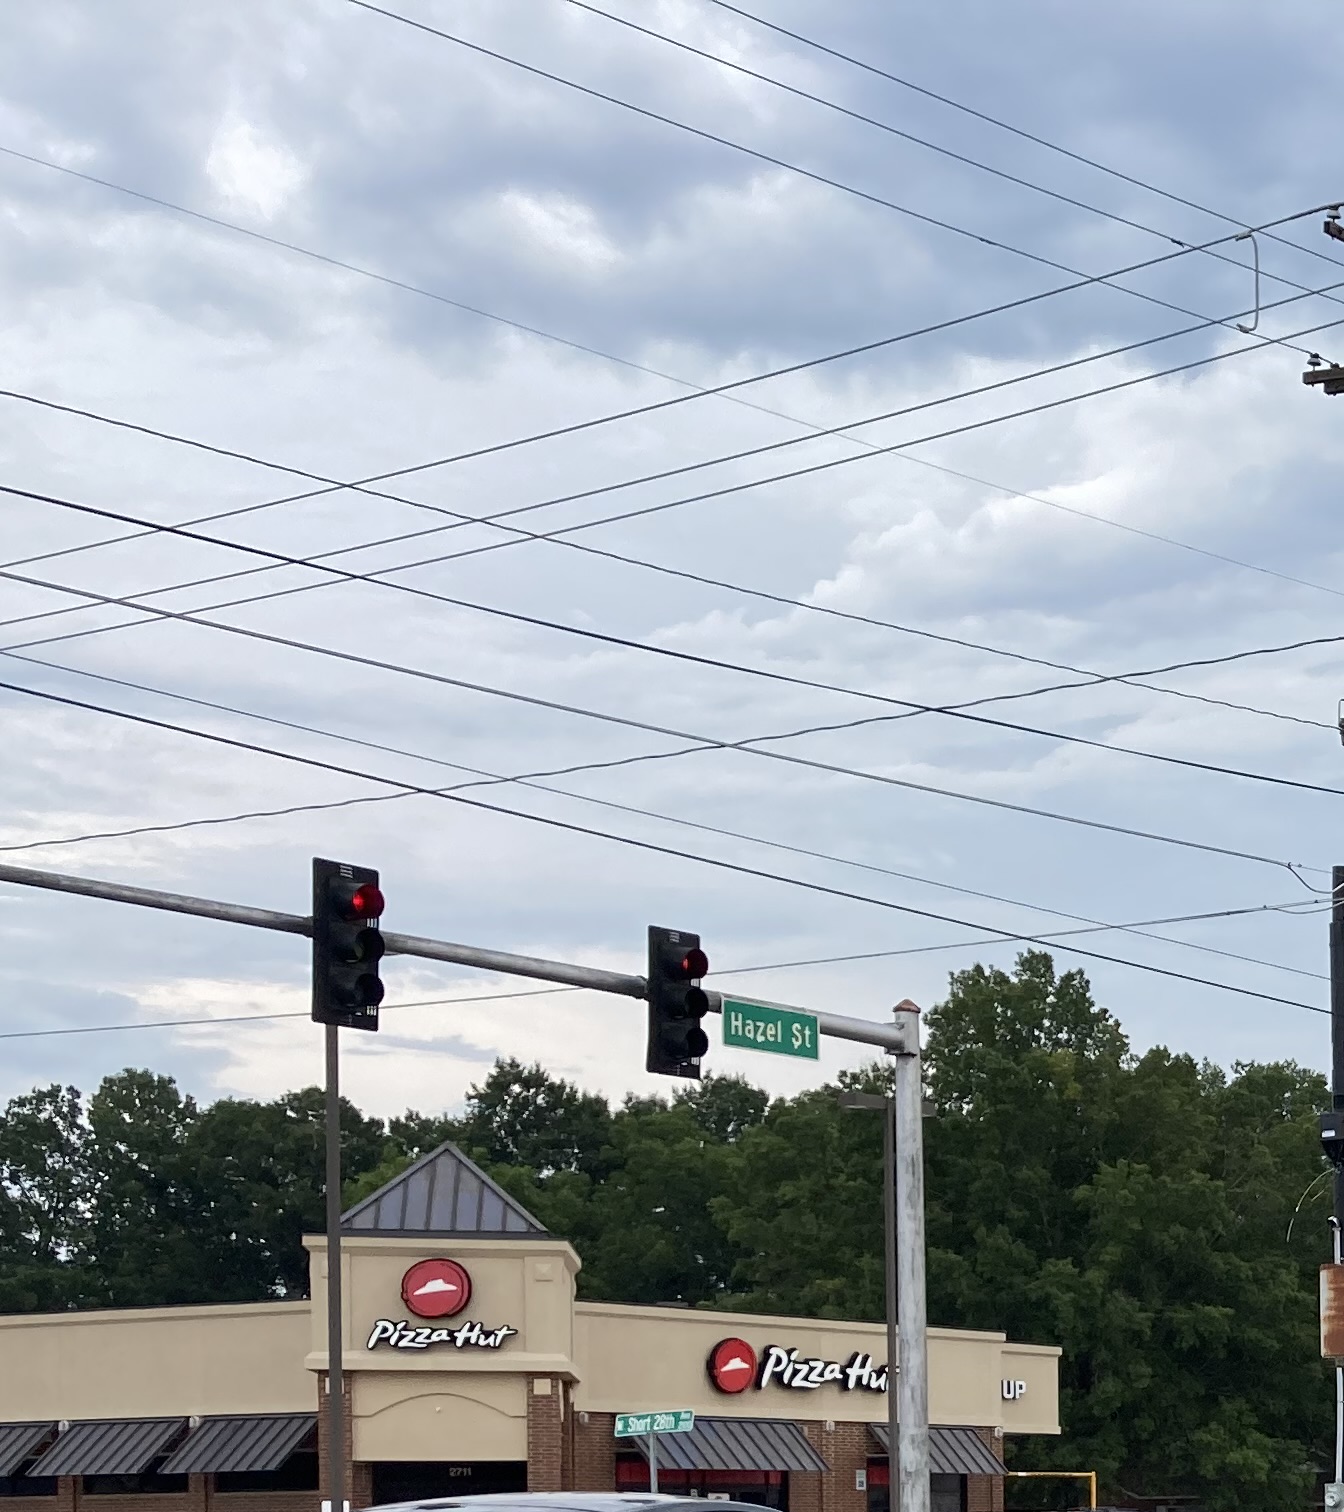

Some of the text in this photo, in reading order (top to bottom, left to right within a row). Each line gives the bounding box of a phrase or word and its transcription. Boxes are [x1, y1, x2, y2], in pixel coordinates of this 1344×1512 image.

[730, 1011, 811, 1049] Hazel St
[366, 1319, 518, 1350] Pizza Hut
[760, 1346, 844, 1390] Pizza
[1001, 1379, 1027, 1399] UP
[627, 1416, 651, 1432] Short
[653, 1413, 675, 1430] 28th
[449, 1467, 472, 1477] 2711
